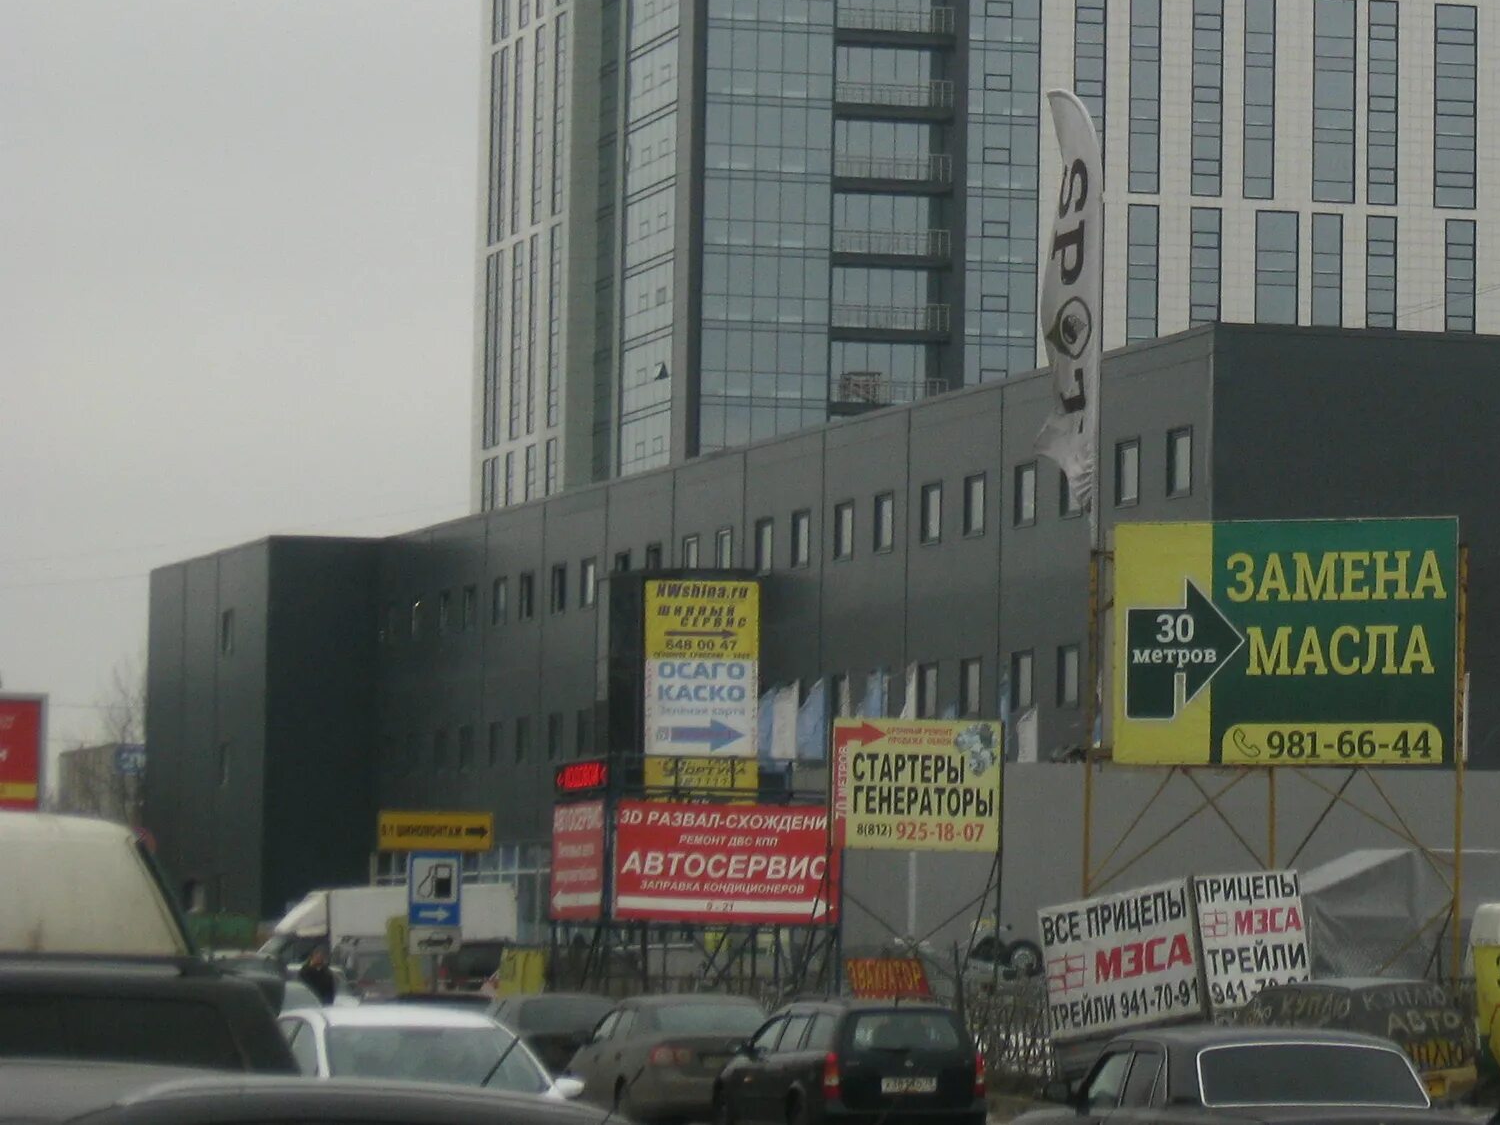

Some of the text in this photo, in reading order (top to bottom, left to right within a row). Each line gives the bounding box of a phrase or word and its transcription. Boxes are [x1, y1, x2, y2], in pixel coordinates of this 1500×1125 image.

[1226, 549, 1447, 603] ЗАМЕНА
[1156, 615, 1195, 644] 30
[1132, 647, 1218, 669] метров
[1245, 624, 1436, 676] МАСЛА
[657, 661, 746, 680] ОСАГО
[657, 684, 746, 702] КАСКО
[1266, 730, 1432, 759] 981-66-44
[852, 752, 966, 785] СТАРТЕРЫ
[852, 784, 994, 818] ГЕНЕРАТОРЫ
[620, 808, 828, 832] 3D РАЗВАЛ-СХОЖДЕНИ
[856, 821, 985, 843] 8(812) 925-18-07
[679, 834, 778, 848] РЕМОНТ ДВС КПП
[620, 851, 827, 881] АВТОСЕРВИС
[639, 880, 804, 895] ЗАПРАВКА КОНДИЦИОНЕРОВ
[1195, 873, 1300, 905] ПРИЦЕПЫ
[1041, 886, 1187, 947] ВСЕ ПРИЦЕПЫ
[1233, 906, 1303, 936] МЗСА
[1094, 932, 1194, 985] МЗСА
[1207, 939, 1308, 976] ТРЕЙЛИ
[1050, 989, 1117, 1031] ТРЕЙЛИ
[1121, 977, 1201, 1020] 941-70-91
[1387, 1010, 1461, 1036] АВТО
